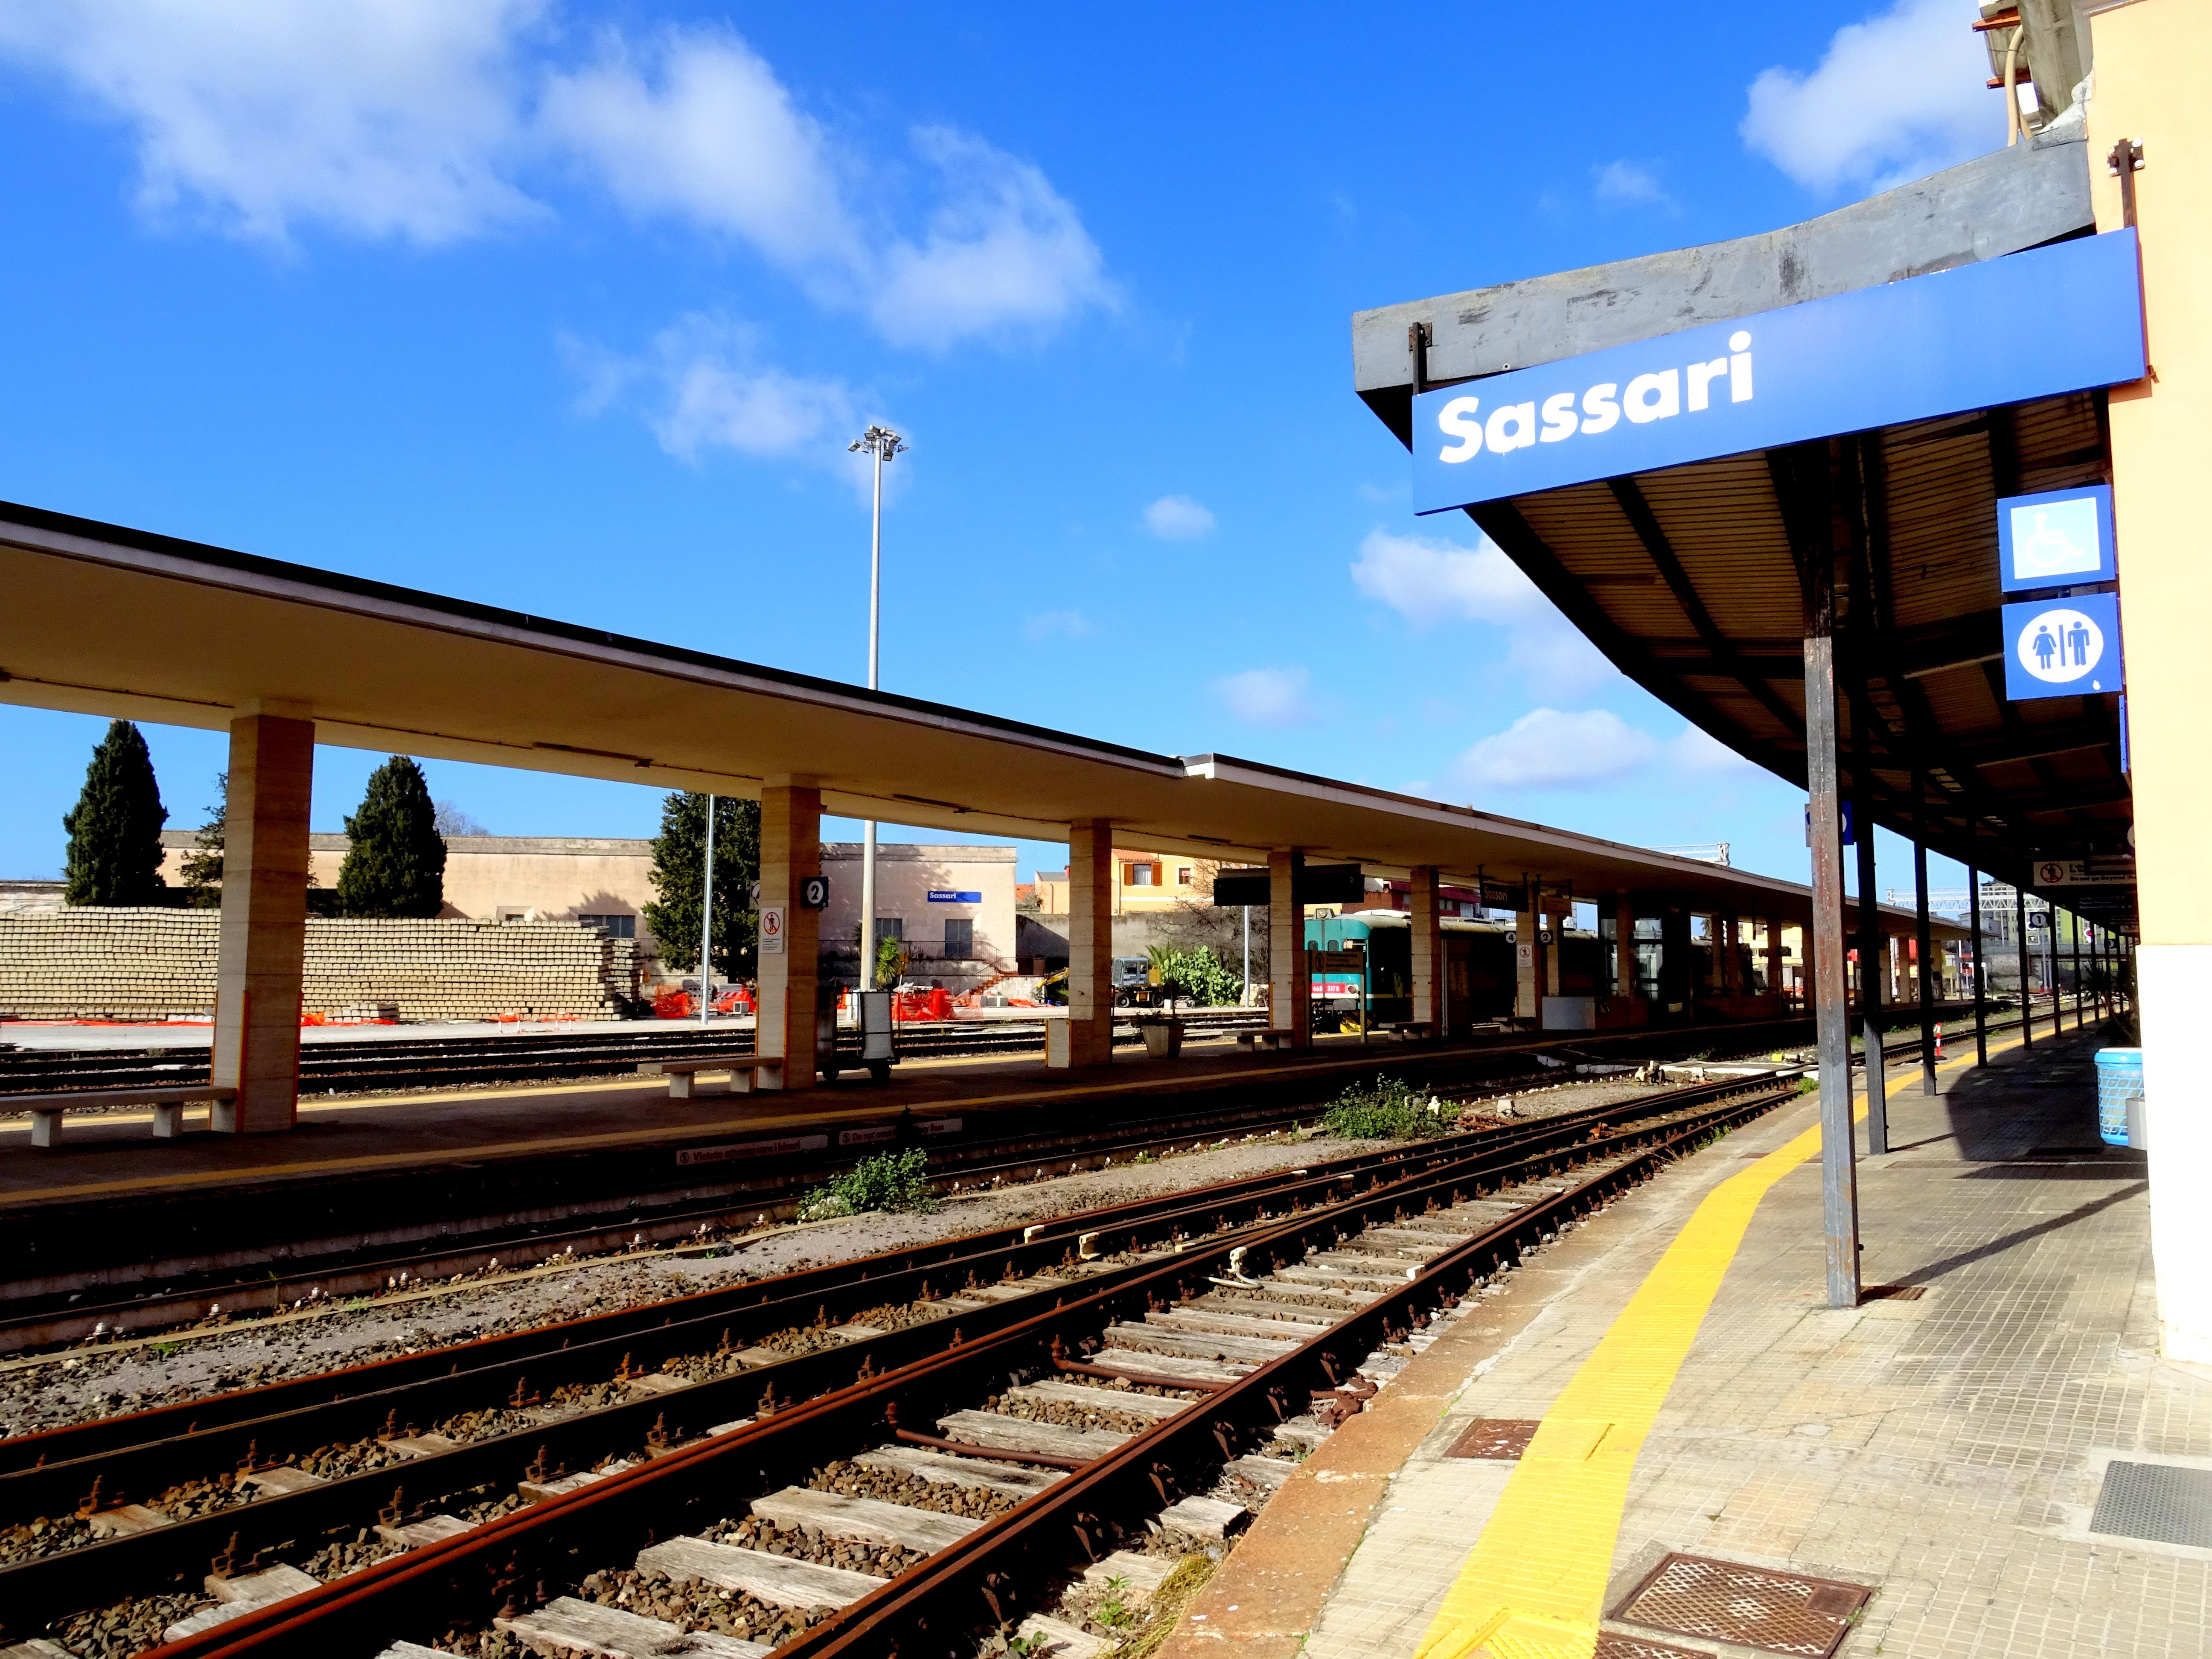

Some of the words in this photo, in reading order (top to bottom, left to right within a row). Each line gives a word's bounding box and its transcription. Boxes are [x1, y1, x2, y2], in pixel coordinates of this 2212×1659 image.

[1439, 331, 1752, 463] Sassari
[811, 885, 819, 899] 2
[1484, 886, 1508, 901] Sassari
[2037, 915, 2041, 924] 1
[930, 1123, 944, 1132] lines
[693, 1152, 723, 1161] Vietato
[725, 1147, 773, 1157] attraversare
[778, 1141, 800, 1151] binari
